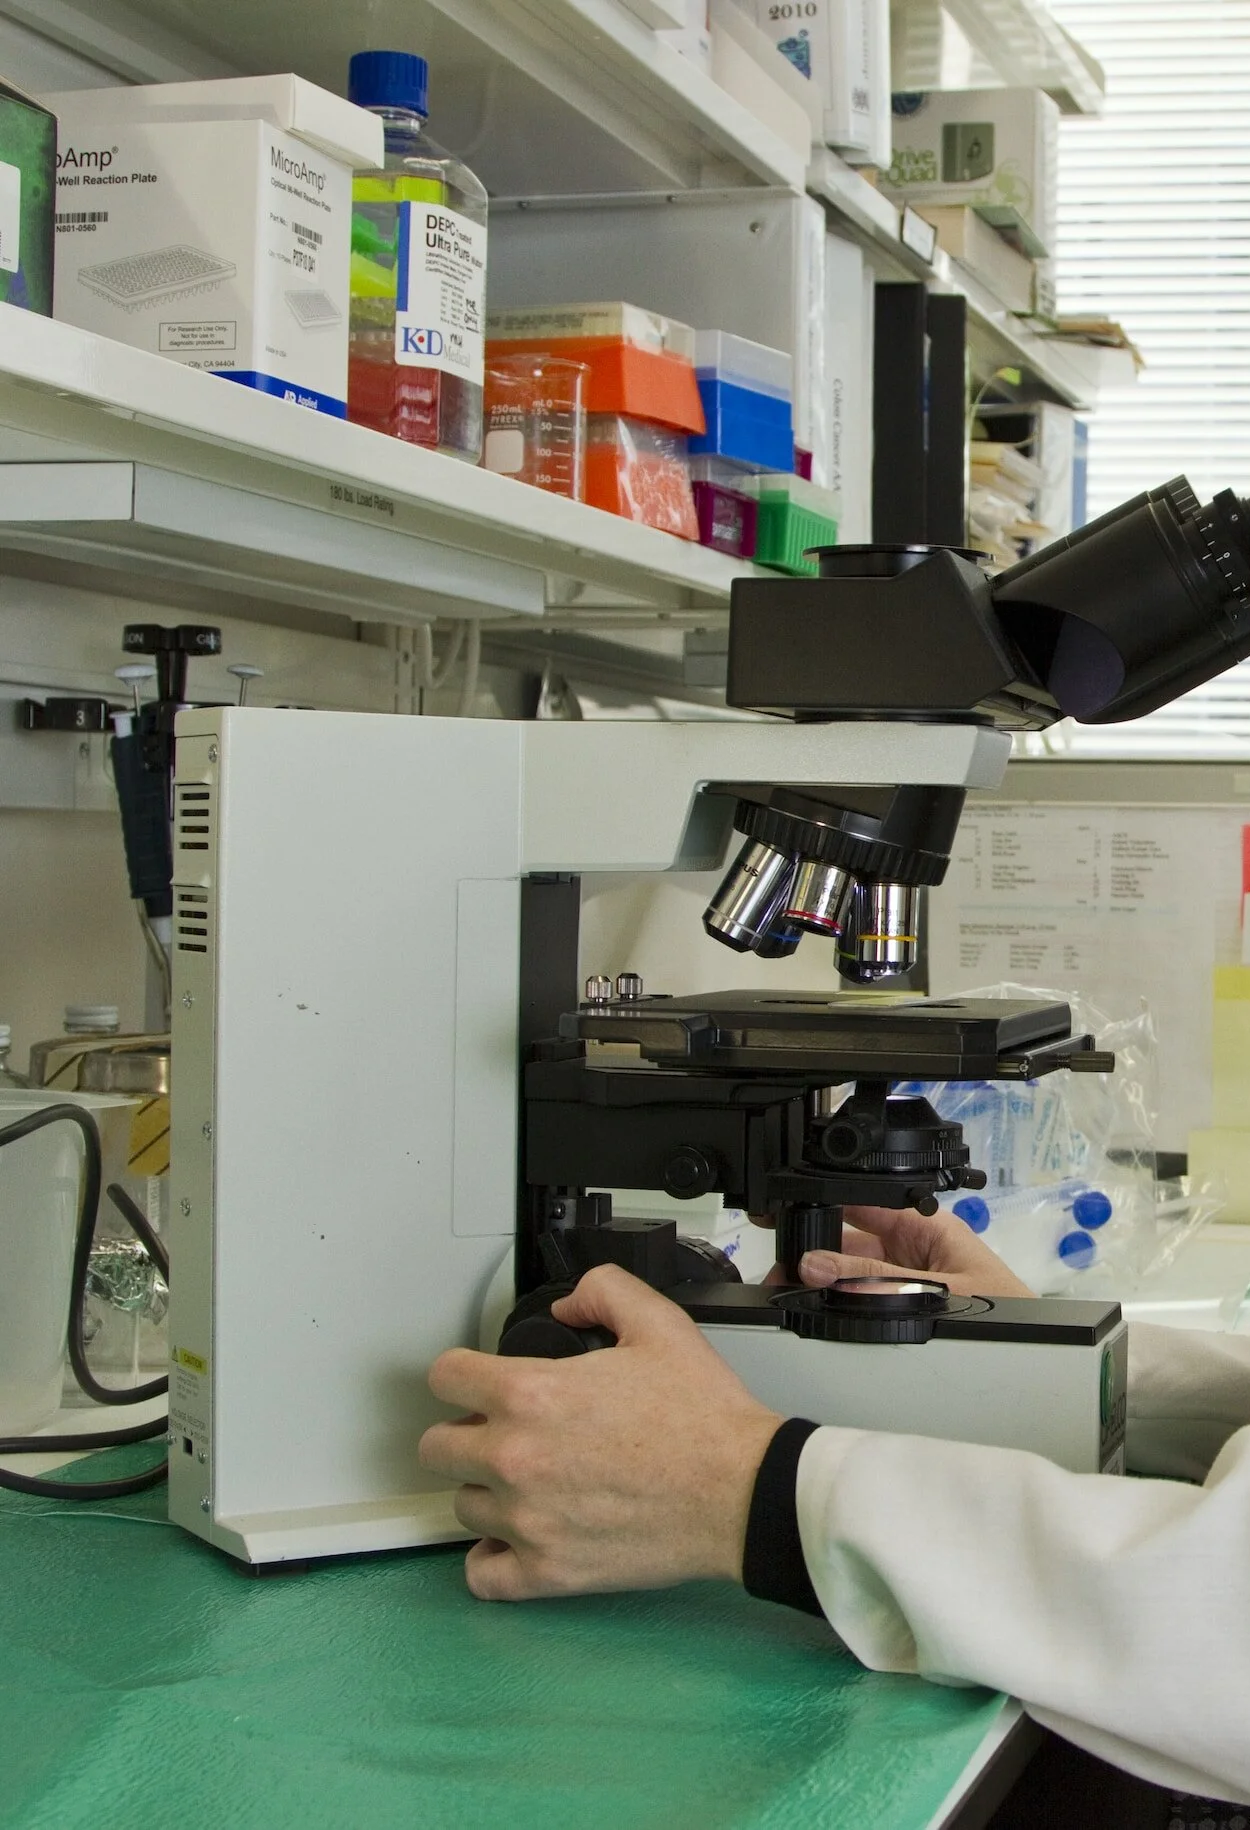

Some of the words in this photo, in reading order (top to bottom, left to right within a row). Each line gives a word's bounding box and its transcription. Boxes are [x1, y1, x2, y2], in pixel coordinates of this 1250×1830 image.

[768, 2, 817, 21] 2010
[82, 175, 128, 185] Reaction
[131, 173, 158, 184] Plate
[426, 214, 456, 237] DEPC
[426, 232, 452, 253] Ultra
[453, 240, 471, 262] Pure
[540, 422, 552, 431] 50
[536, 448, 552, 457] 100
[535, 474, 552, 483] 150
[75, 710, 86, 727] 3
